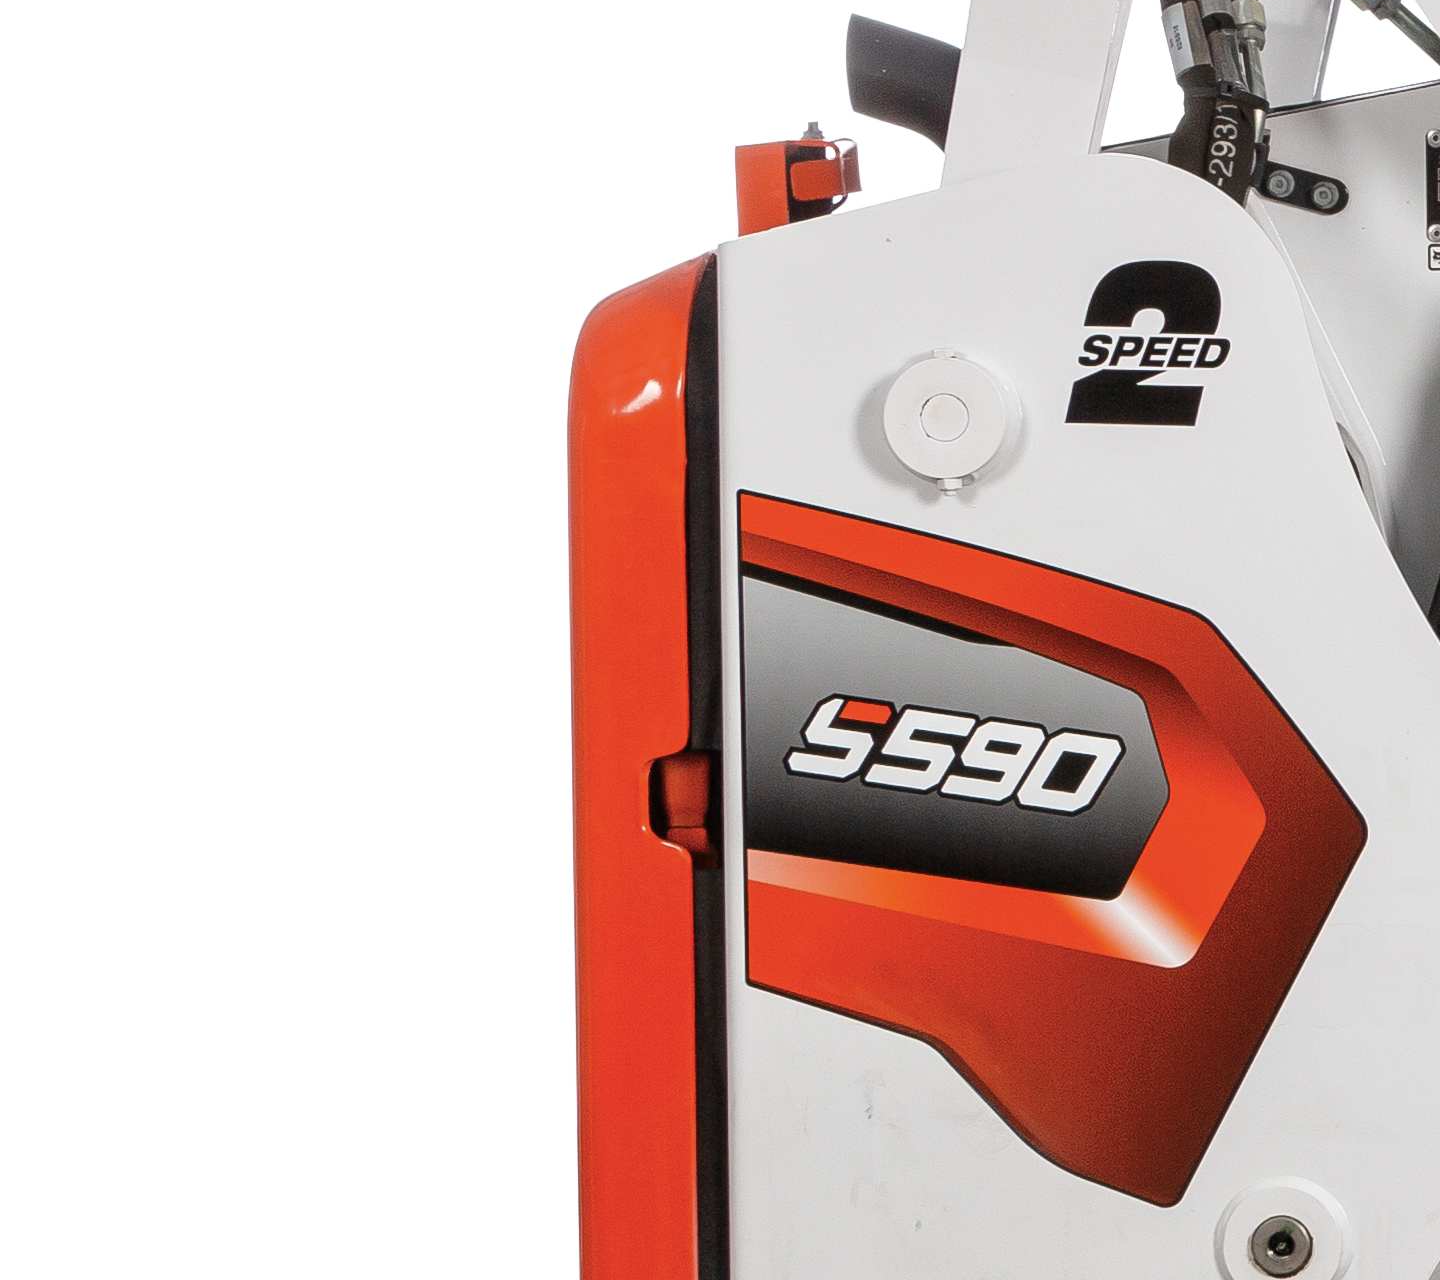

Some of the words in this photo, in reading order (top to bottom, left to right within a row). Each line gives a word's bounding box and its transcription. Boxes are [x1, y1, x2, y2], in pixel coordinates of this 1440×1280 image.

[1064, 260, 1223, 427] 2
[1078, 333, 1231, 370] SPEED
[787, 694, 1125, 814] S590
